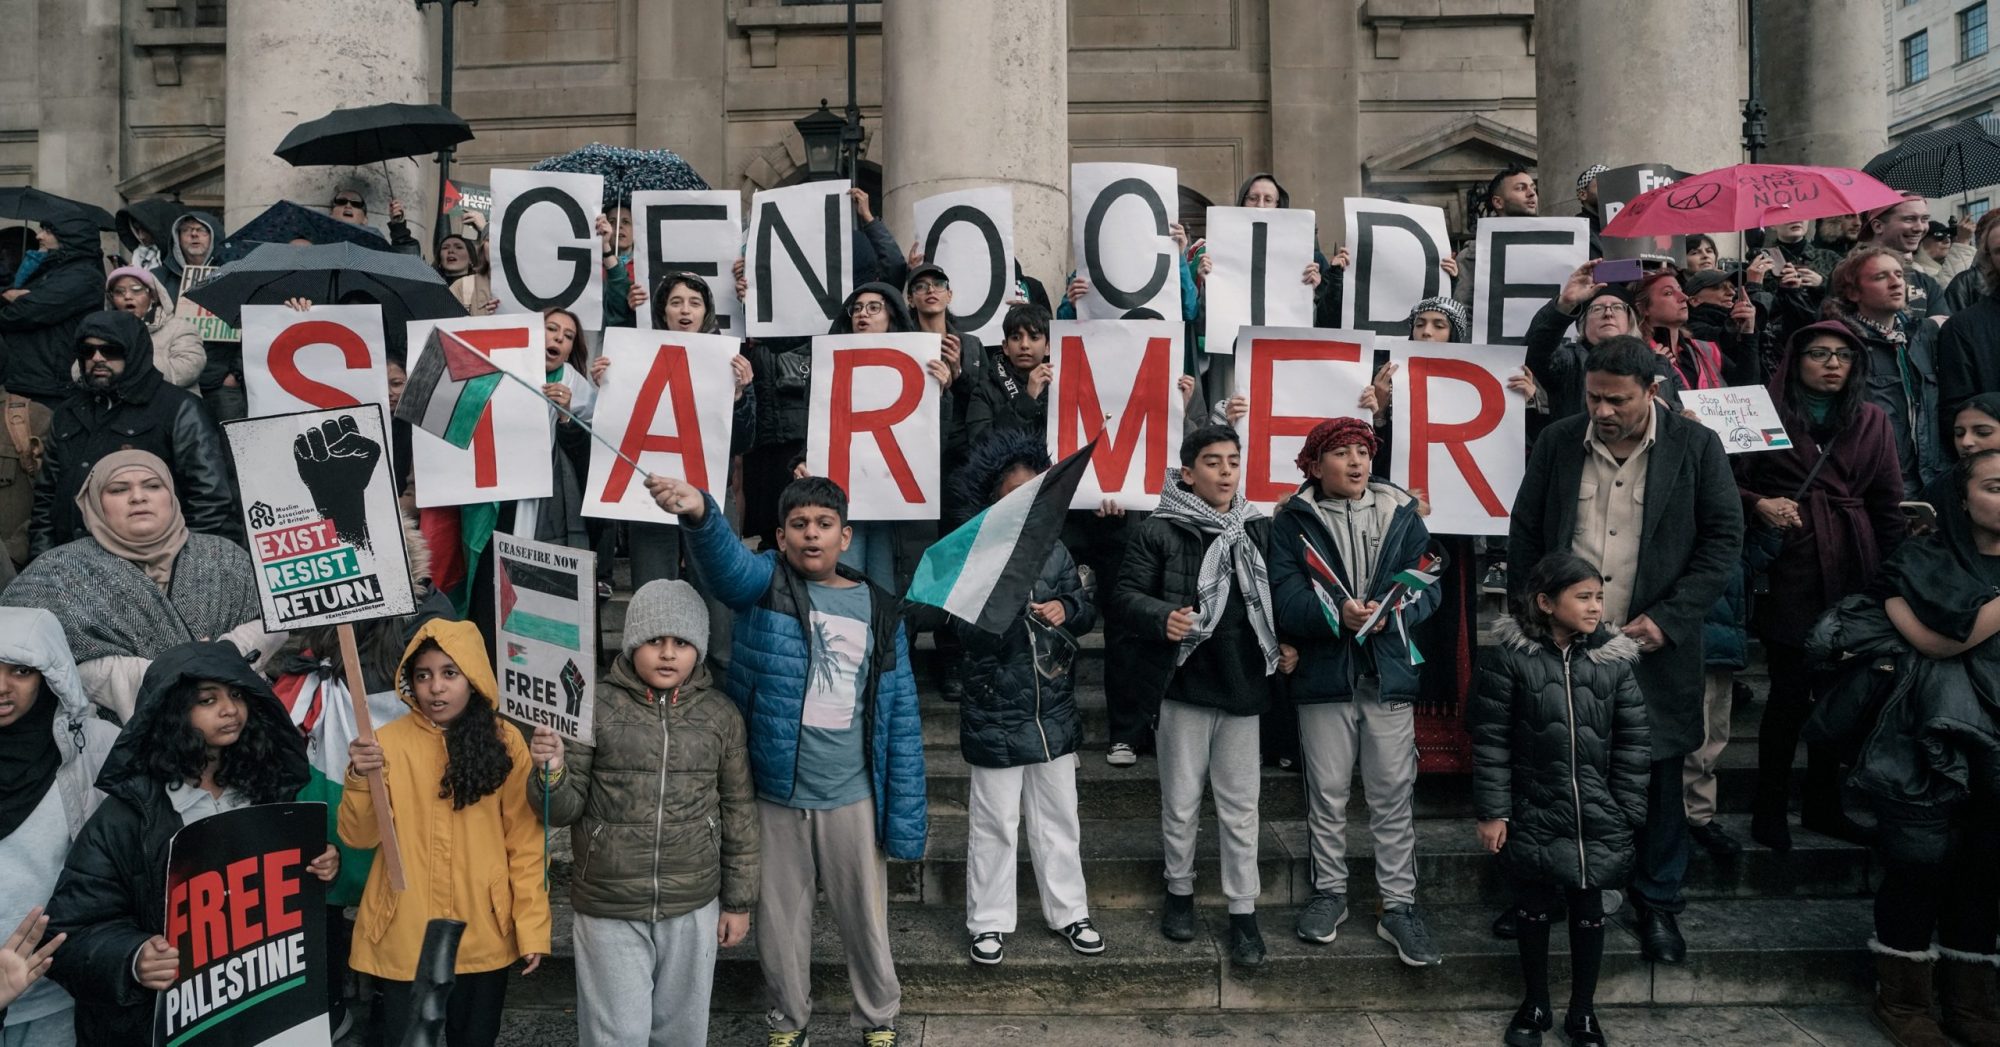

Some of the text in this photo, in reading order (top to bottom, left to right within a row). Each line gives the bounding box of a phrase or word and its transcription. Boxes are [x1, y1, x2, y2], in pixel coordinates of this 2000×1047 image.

[1753, 183, 1820, 208] NOW
[1697, 393, 1752, 408] Stop Killing
[1700, 405, 1737, 417] Children
[275, 504, 299, 513] Muslim
[277, 507, 315, 519] Association
[287, 515, 310, 524] Britain
[256, 523, 338, 559] EXIST.
[498, 540, 579, 570] CEASEFIRE NOW
[265, 552, 359, 589] RESIST.
[274, 578, 382, 620] RETURN.
[505, 667, 557, 707] FREE
[506, 698, 579, 738] PALESTINE
[168, 847, 303, 980] FREE
[165, 931, 306, 1037] PALESTINE
